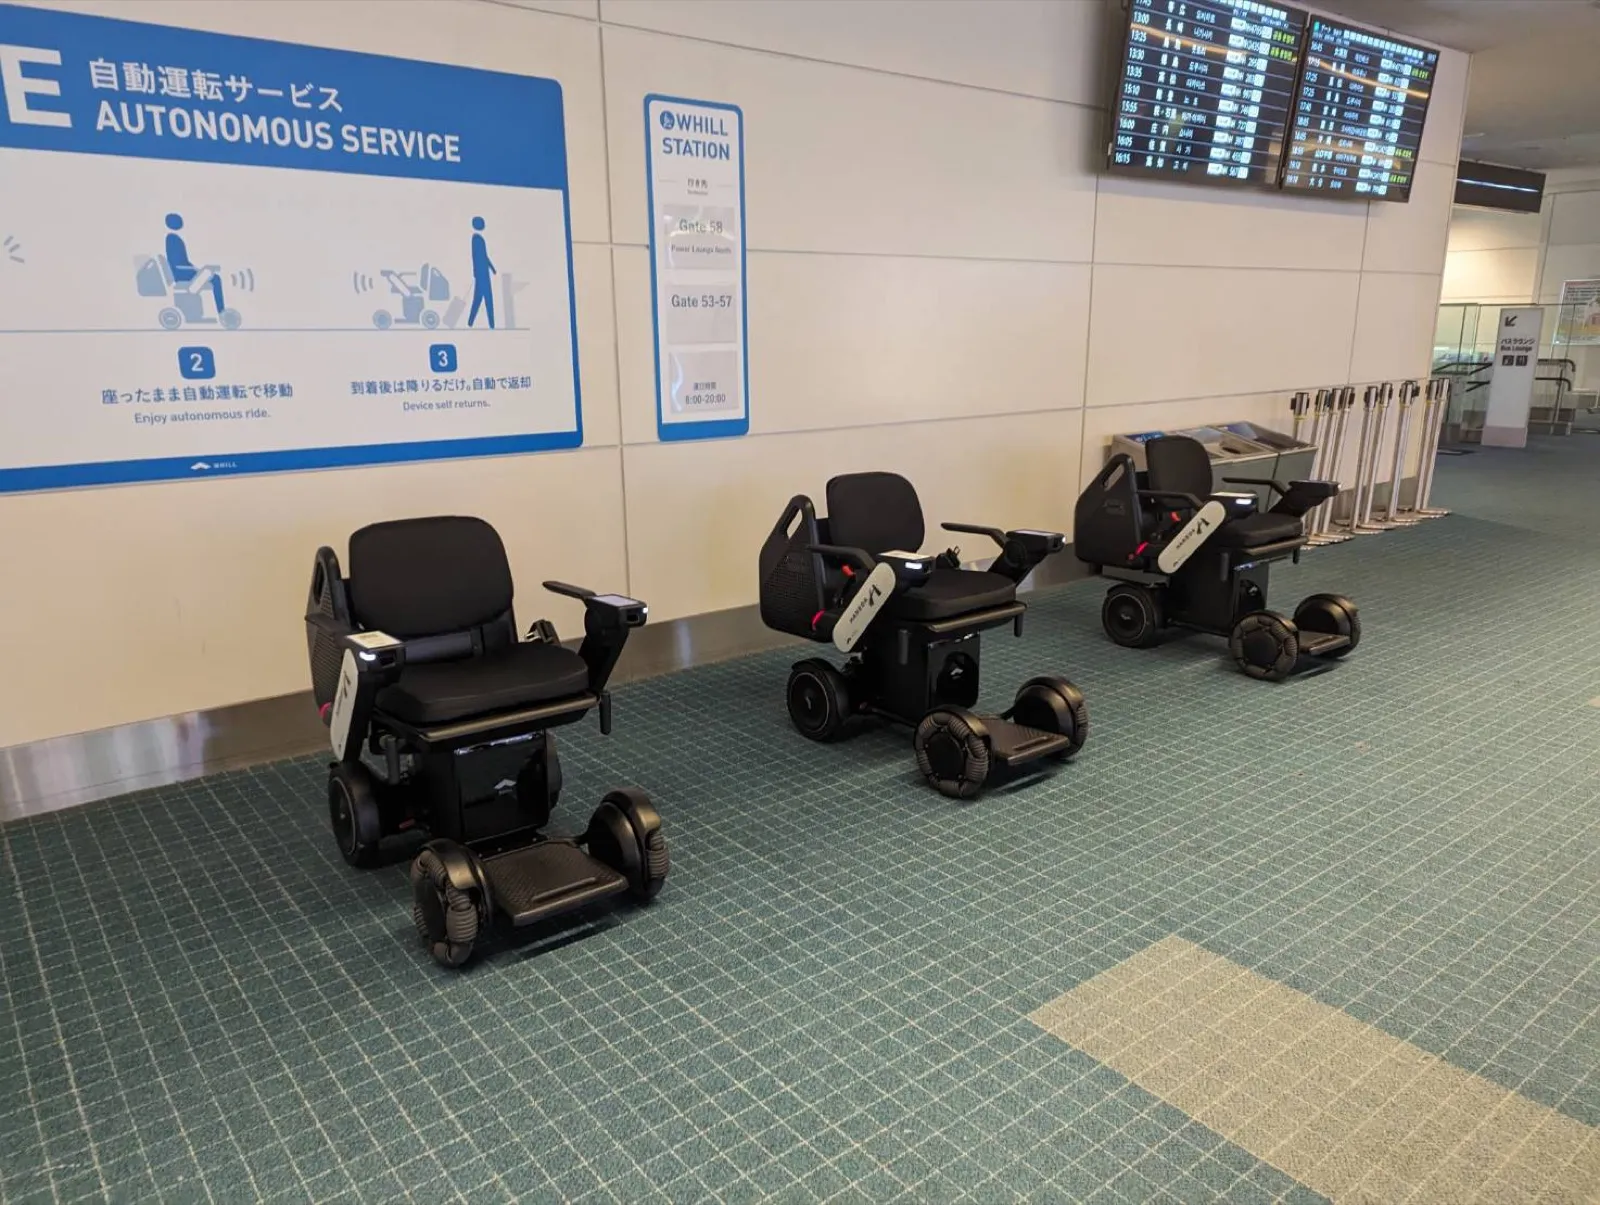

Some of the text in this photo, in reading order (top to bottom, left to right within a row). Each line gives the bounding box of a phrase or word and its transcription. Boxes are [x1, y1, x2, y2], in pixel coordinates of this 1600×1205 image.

[0, 44, 72, 129] E
[89, 58, 343, 112] 自動運転サービス
[95, 101, 461, 163] AUTONOMOUS SERVICE
[677, 114, 728, 137] WHILL
[662, 137, 731, 161] STATION
[671, 294, 732, 308] Gate 53-57
[190, 353, 204, 373] 2
[437, 350, 449, 368] 3
[101, 382, 293, 405] 座ったまま自動運転で移動
[350, 375, 532, 396] 到着後は降りるだけ。自動で返却
[134, 407, 271, 425] Enjoy autonomous ride.
[403, 398, 492, 412] Device self returns.
